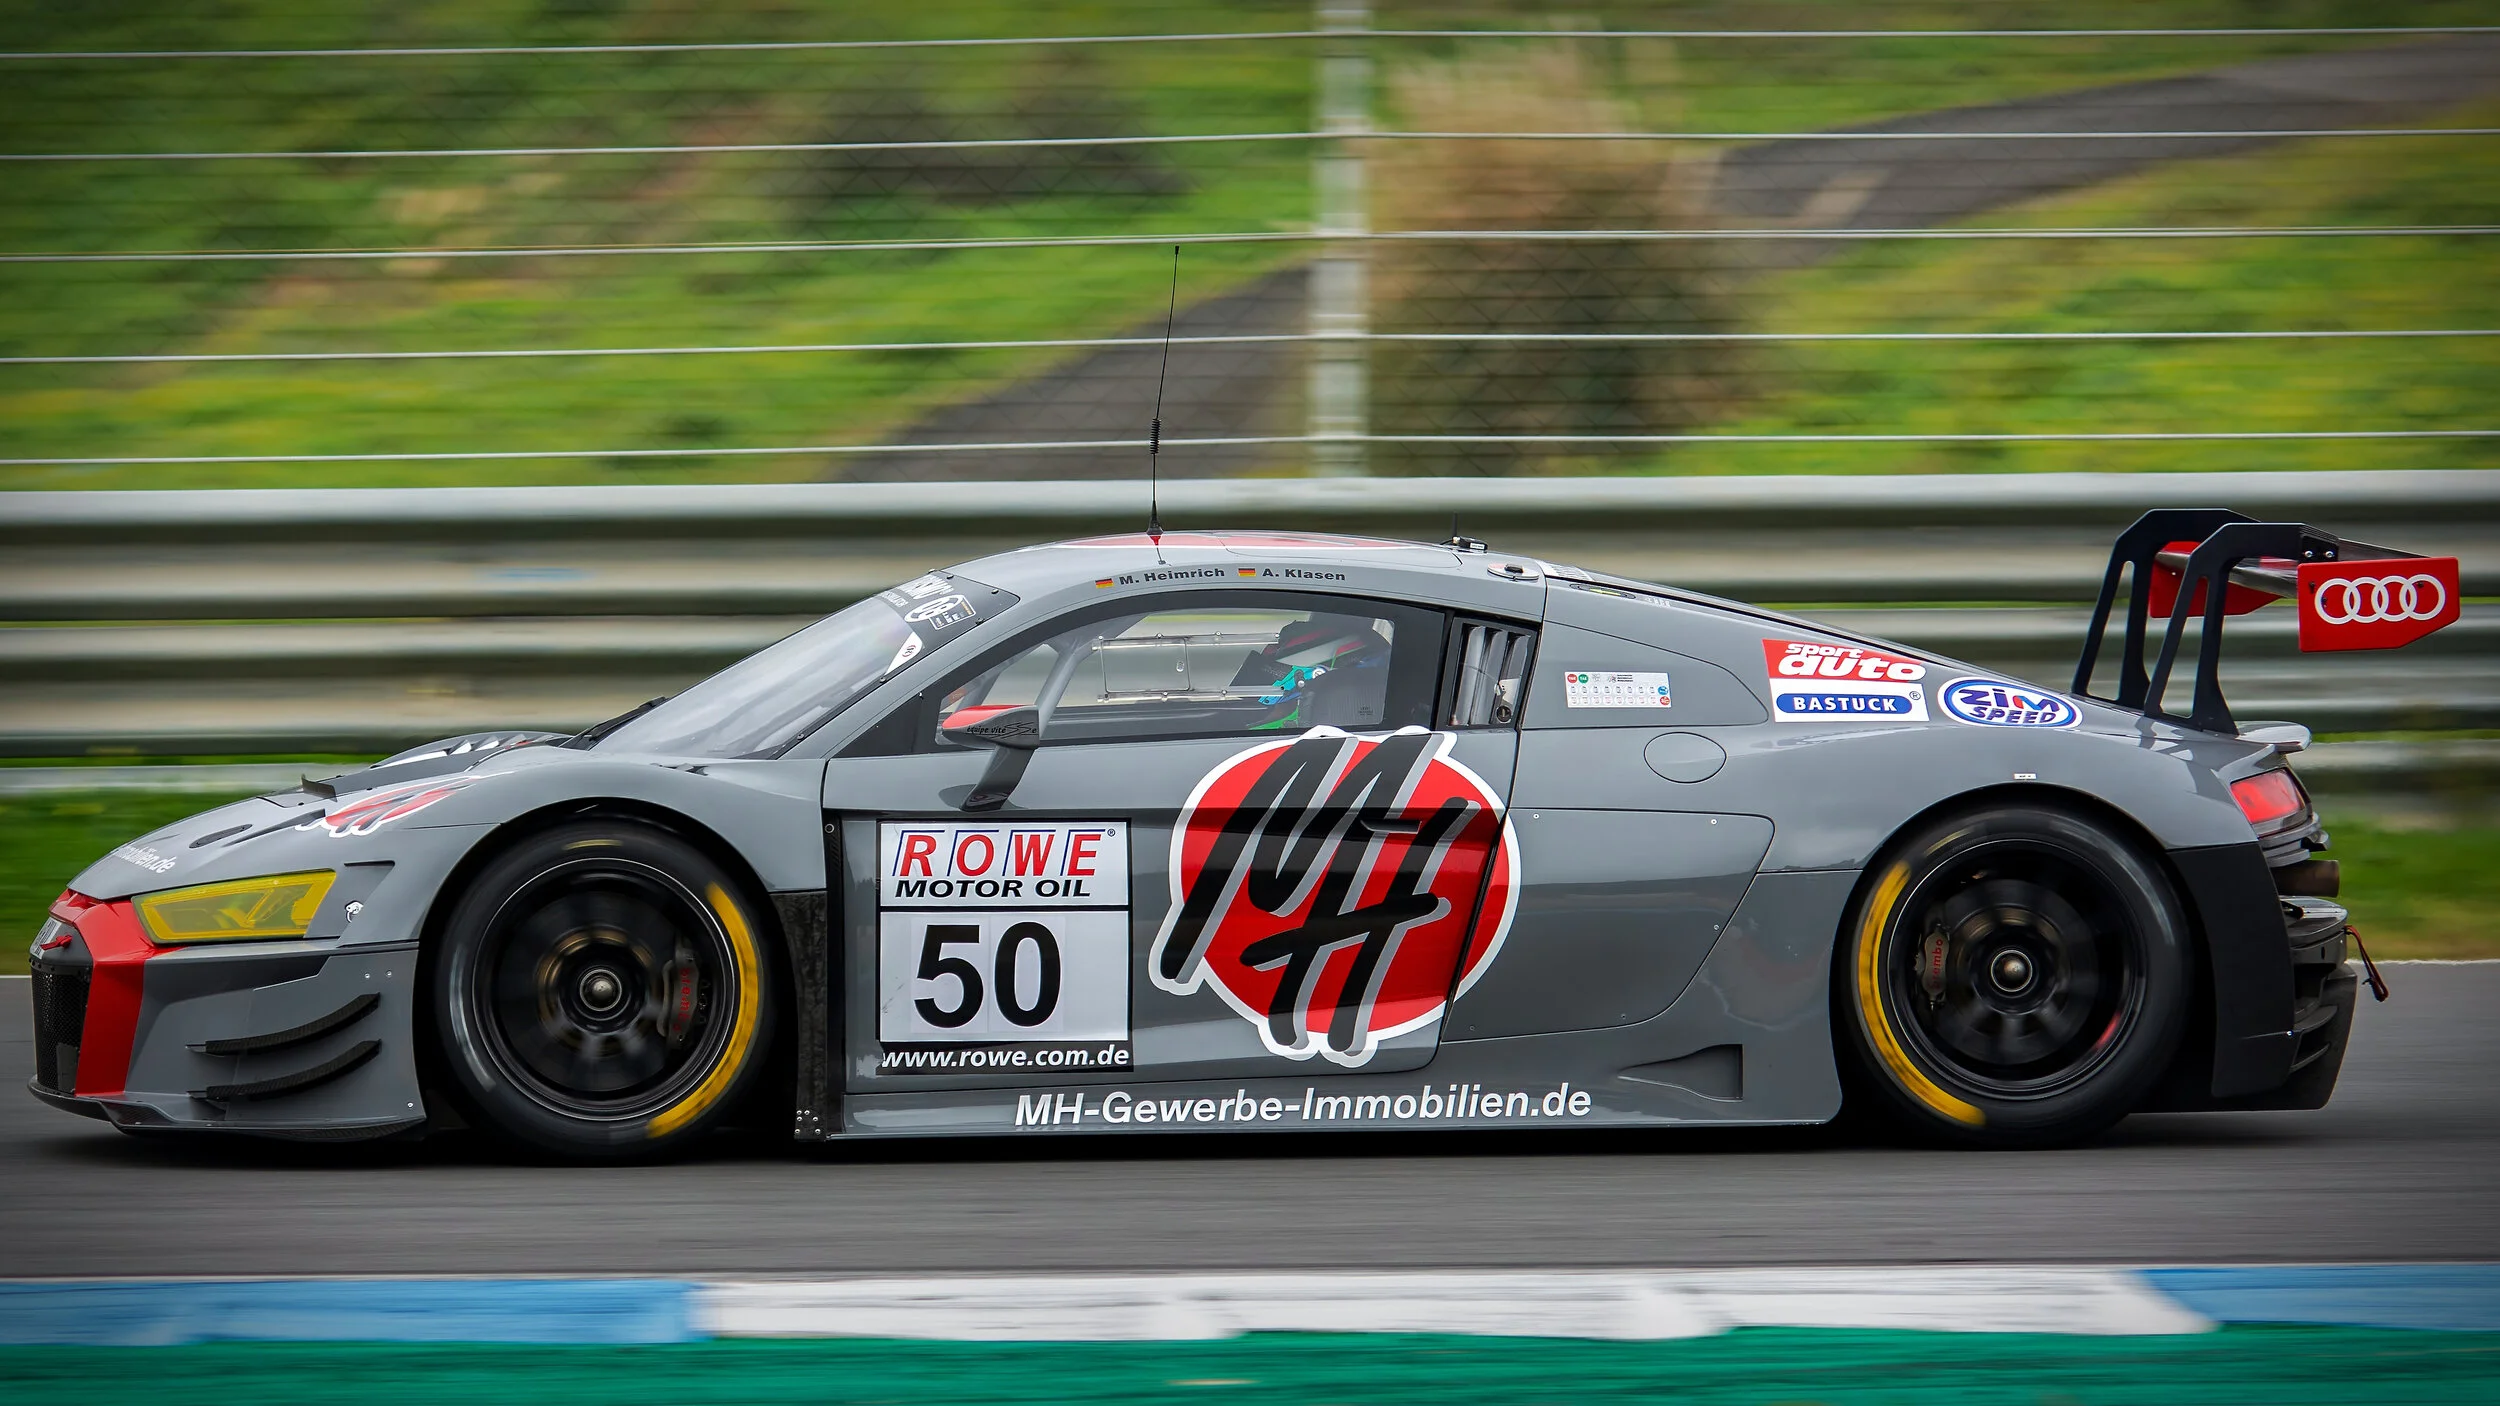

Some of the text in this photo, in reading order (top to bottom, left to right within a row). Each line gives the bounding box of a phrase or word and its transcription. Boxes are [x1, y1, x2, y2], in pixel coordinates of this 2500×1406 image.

[1119, 567, 1226, 585] M. Heimrich
[1262, 567, 1346, 581] A. Klasen
[1785, 643, 1864, 658] sport
[1777, 651, 1927, 682] auto
[1792, 696, 1898, 712] BASTUCK
[1969, 705, 2057, 724] SPEED
[896, 831, 1102, 877] ROWE
[894, 879, 1091, 898] MOTOR OIL
[913, 921, 1062, 1029] 50
[881, 1044, 1130, 1068] www.rowe.com.de
[1014, 1083, 1593, 1127] MH-Gewerbe-Immobilien.de
